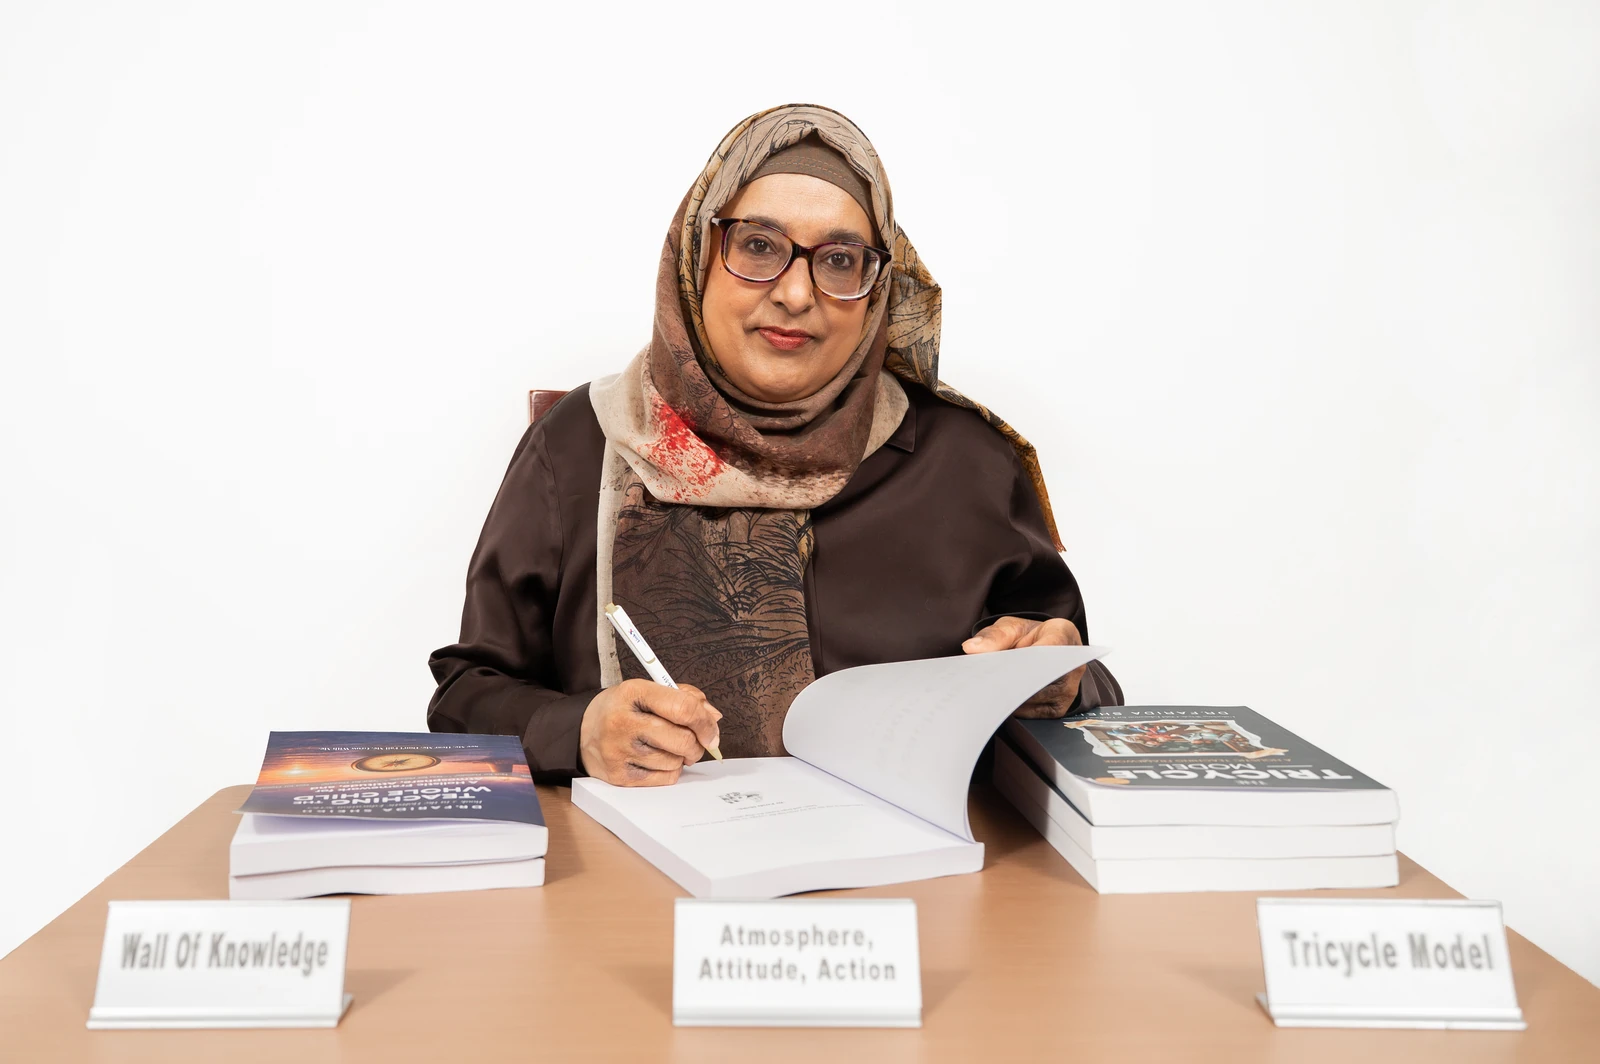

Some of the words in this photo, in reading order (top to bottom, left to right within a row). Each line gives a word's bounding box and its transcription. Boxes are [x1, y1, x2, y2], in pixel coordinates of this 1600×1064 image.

[1107, 769, 1353, 779] TRICYCLE
[293, 792, 379, 800] CHILD
[331, 793, 475, 805] TEACHING
[388, 786, 491, 796] WHOLE
[720, 924, 874, 952] Atmosphere,
[121, 932, 169, 969] Wall
[175, 932, 201, 968] Of
[208, 931, 329, 977] Knowledge
[1282, 930, 1398, 978] Tricycle
[1407, 932, 1494, 970] Model
[699, 957, 807, 984] Attitude,
[817, 957, 896, 981] Action
